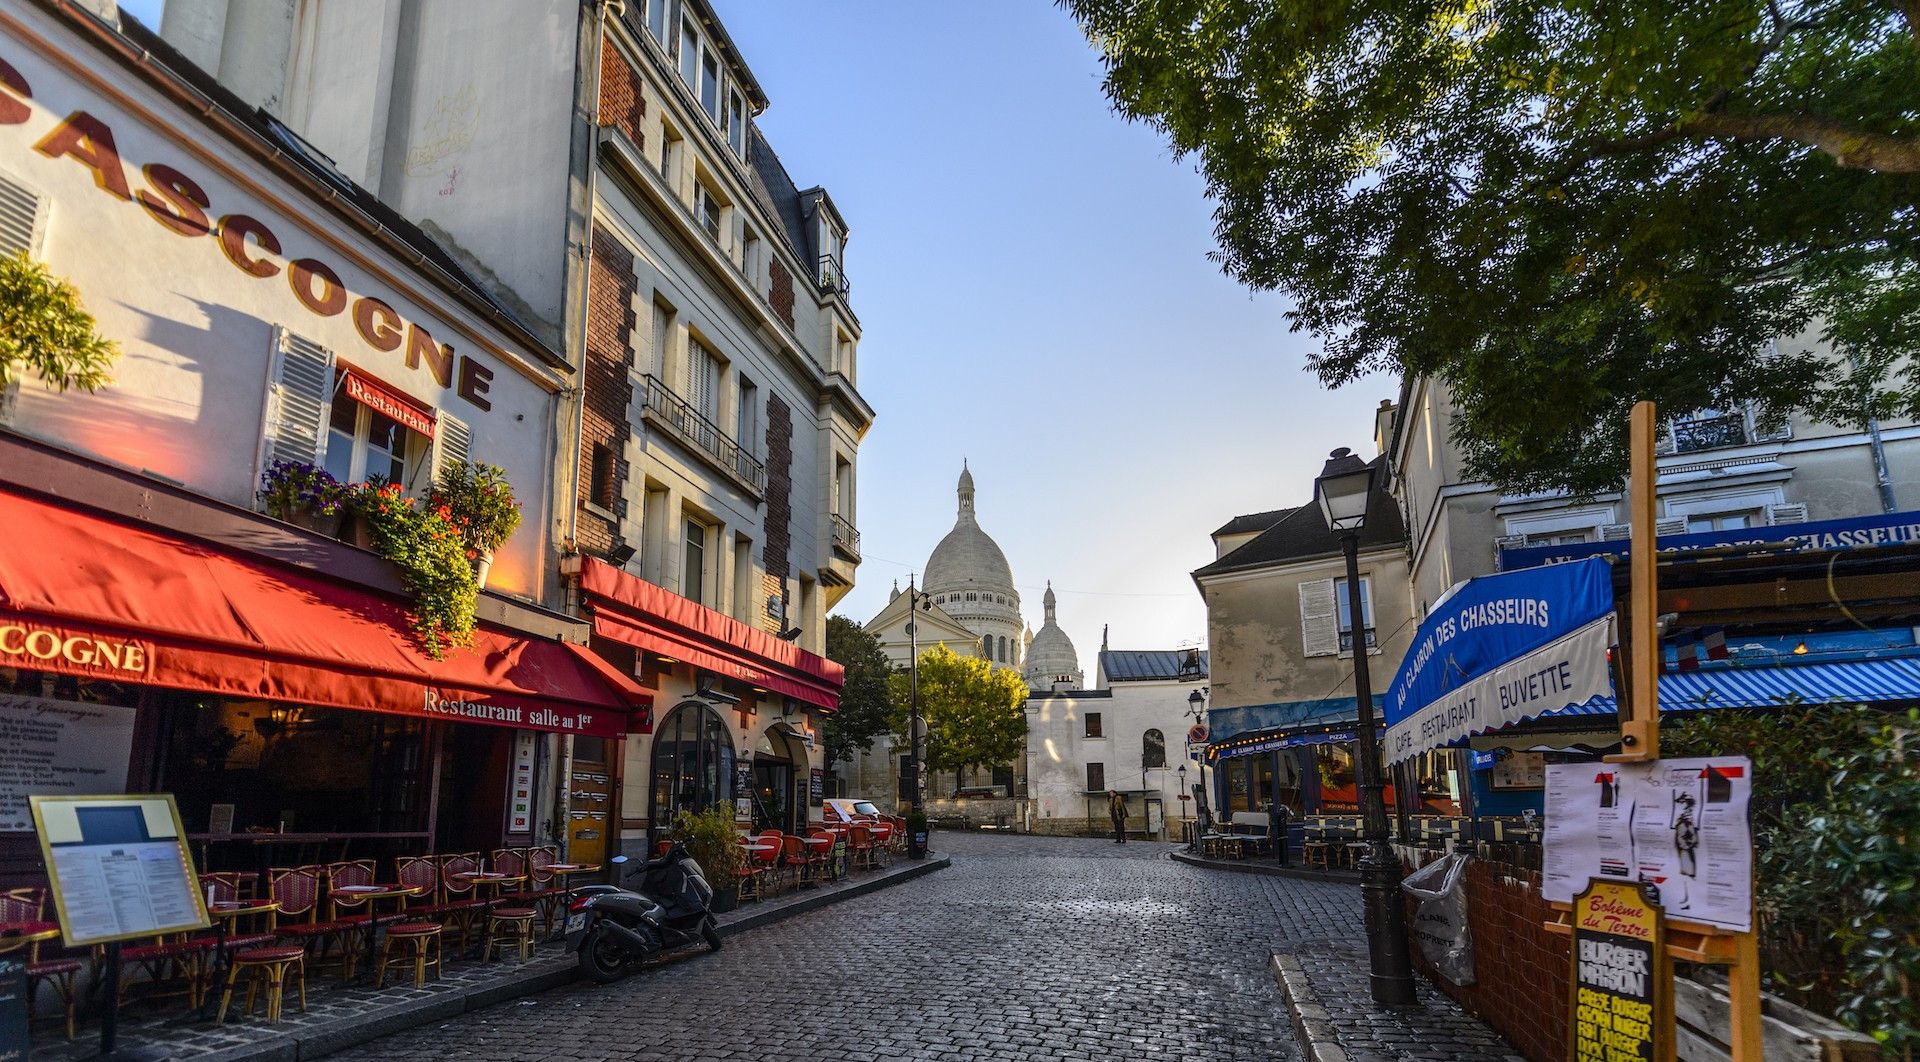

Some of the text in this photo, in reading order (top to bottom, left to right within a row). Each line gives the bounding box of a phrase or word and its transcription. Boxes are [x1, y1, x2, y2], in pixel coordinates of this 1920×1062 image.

[351, 379, 431, 434] Restaurant
[1397, 683, 1406, 710] AU
[1435, 617, 1456, 647] DES
[1460, 598, 1549, 633] CHASSEURS
[1499, 661, 1572, 710] BUVETTE
[424, 690, 593, 730] Restaurant salle au 1er
[1583, 914, 1650, 937] du Tertre
[1590, 895, 1644, 918] Bohème
[1579, 939, 1648, 975] BURGER
[1579, 961, 1644, 997] MAISON
